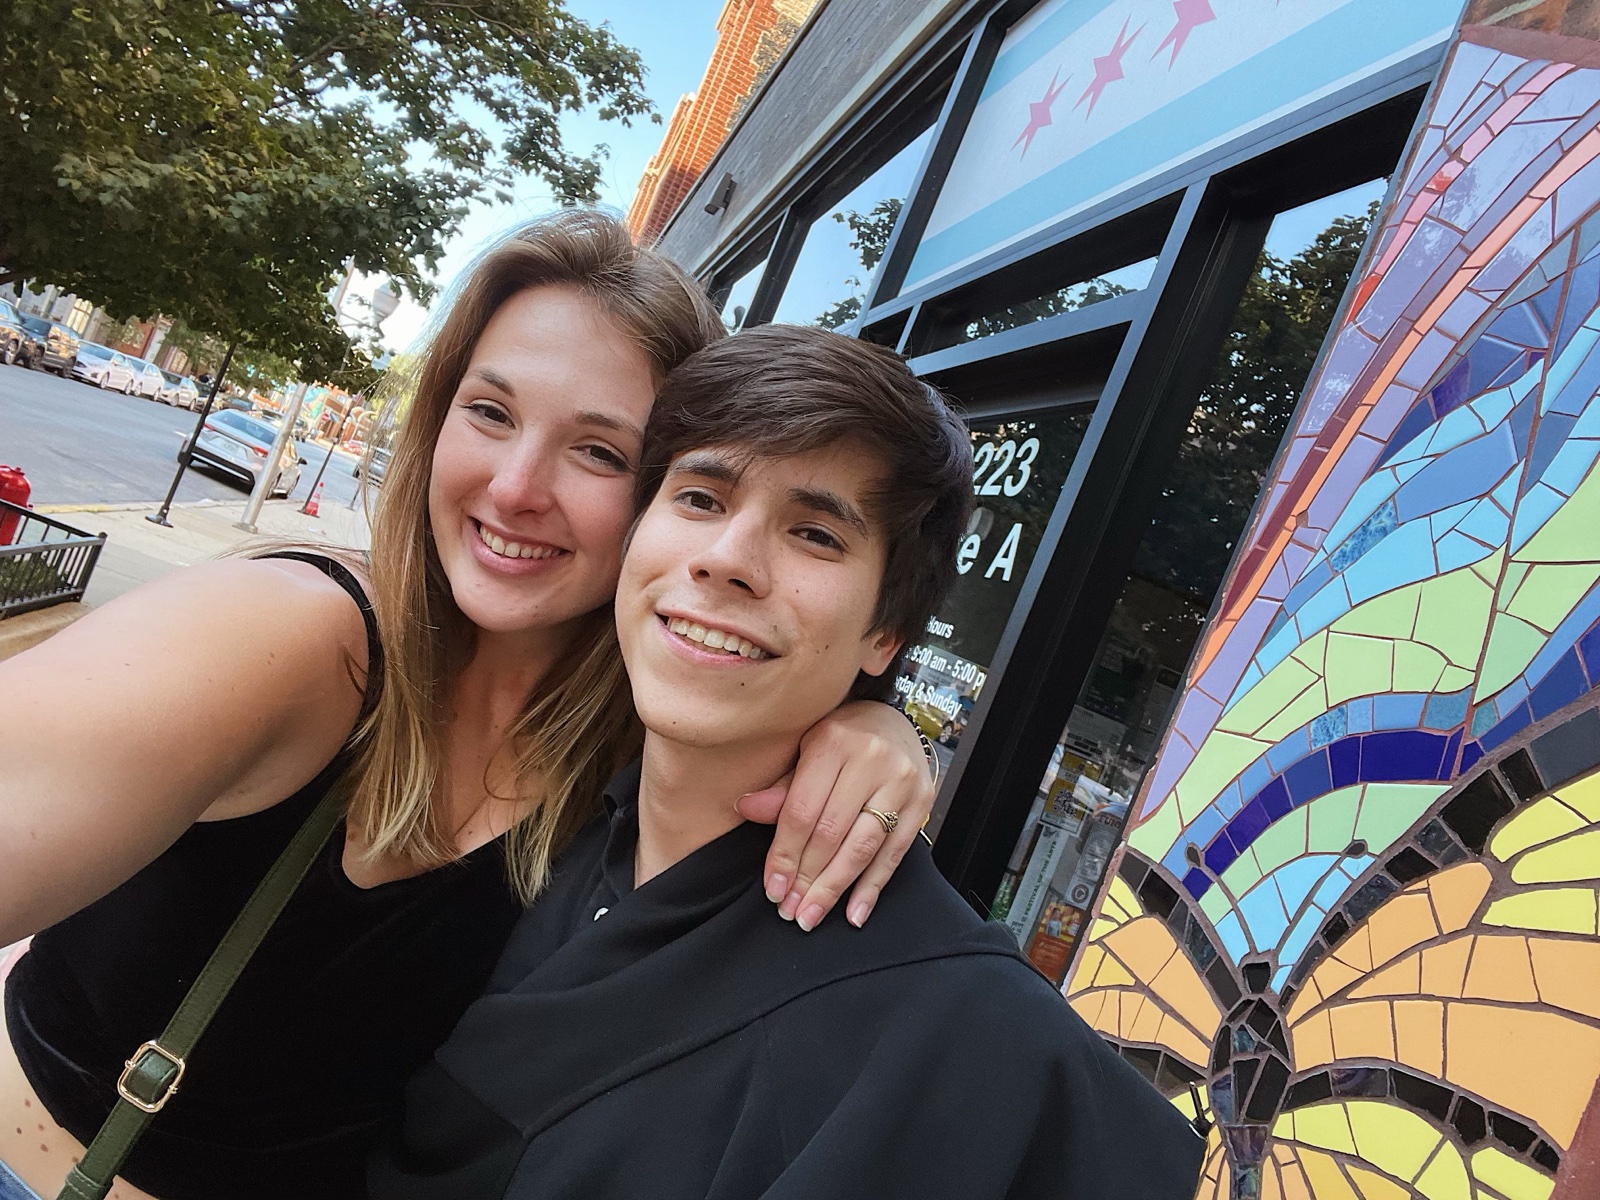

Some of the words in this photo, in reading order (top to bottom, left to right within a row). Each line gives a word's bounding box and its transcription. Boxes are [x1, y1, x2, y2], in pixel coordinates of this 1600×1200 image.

[971, 437, 1040, 497] 223
[983, 522, 1023, 582] A
[911, 645, 932, 666] 9:00
[930, 655, 947, 672] am
[952, 659, 977, 683] 5:00
[915, 683, 925, 699] &
[926, 686, 962, 720] Sunday
[1025, 884, 1040, 916] FESTIVAL
